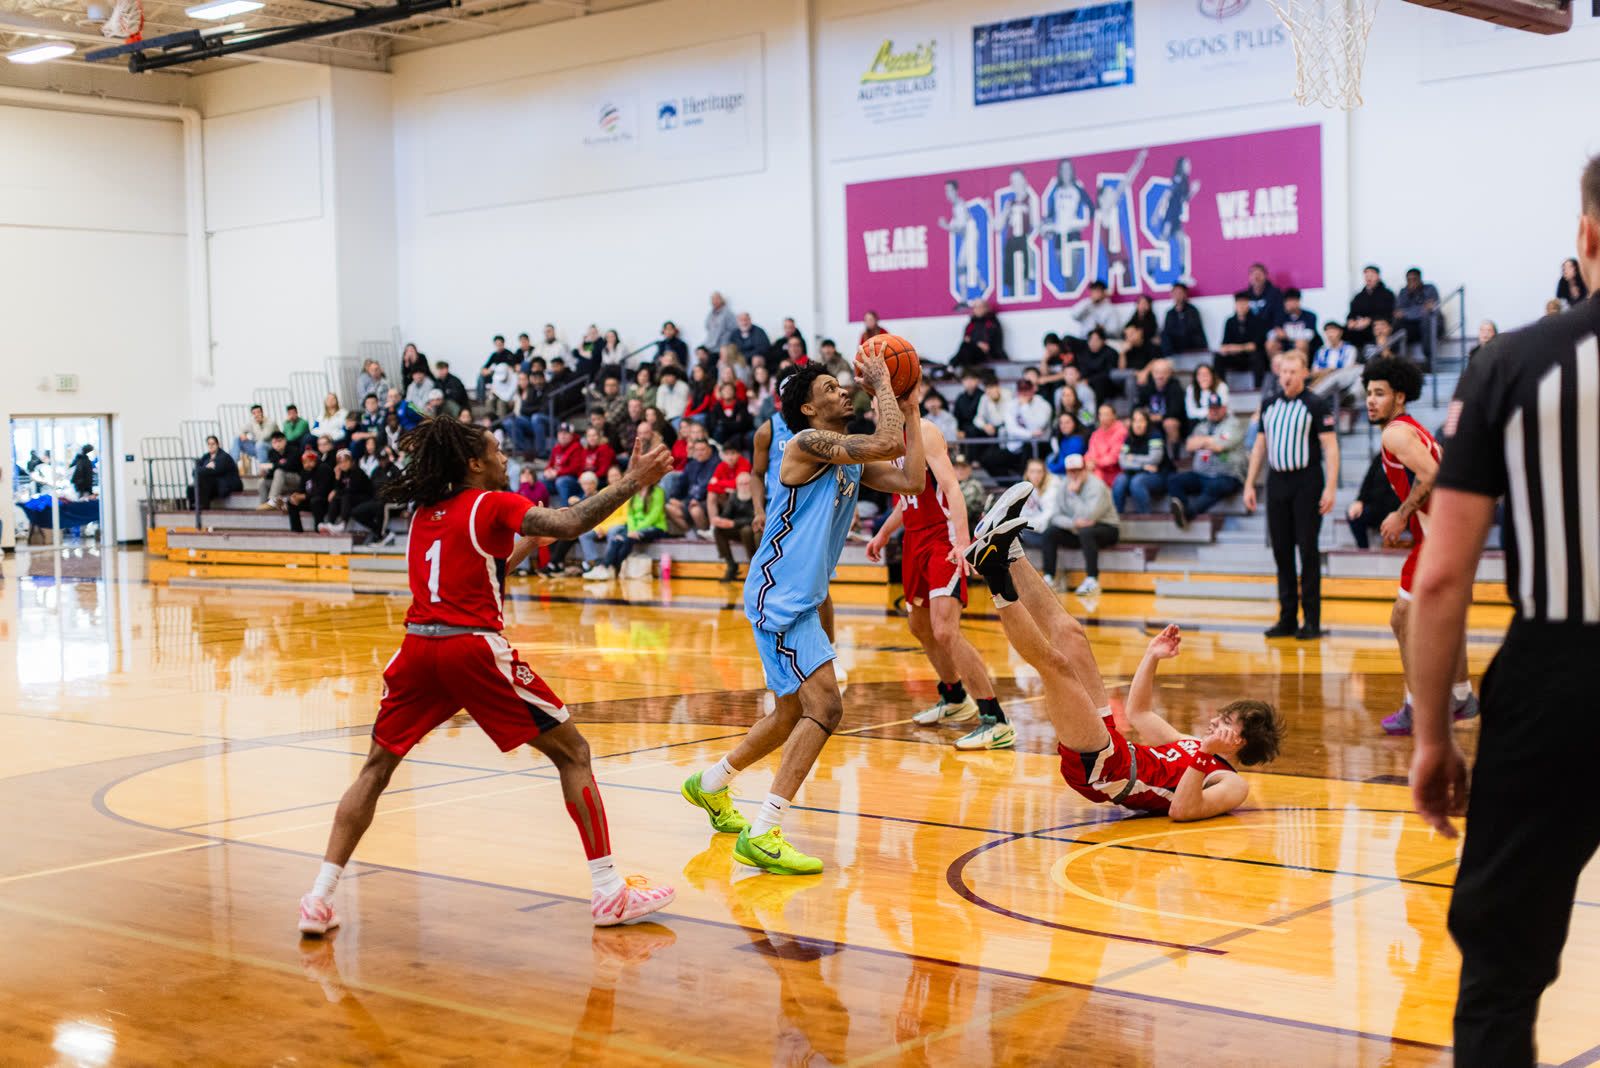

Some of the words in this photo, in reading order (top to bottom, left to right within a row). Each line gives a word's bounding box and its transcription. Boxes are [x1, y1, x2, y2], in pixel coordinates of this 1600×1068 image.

[1166, 33, 1228, 62] SIGNS
[1234, 23, 1285, 51] PLUS
[682, 93, 744, 115] Heritage
[858, 85, 893, 101] AUTO
[896, 79, 937, 95] GLASS
[1216, 188, 1250, 218] WE
[1252, 184, 1298, 215] ARE
[863, 228, 890, 255] WE
[892, 224, 928, 252] ARE
[425, 538, 443, 603] 1
